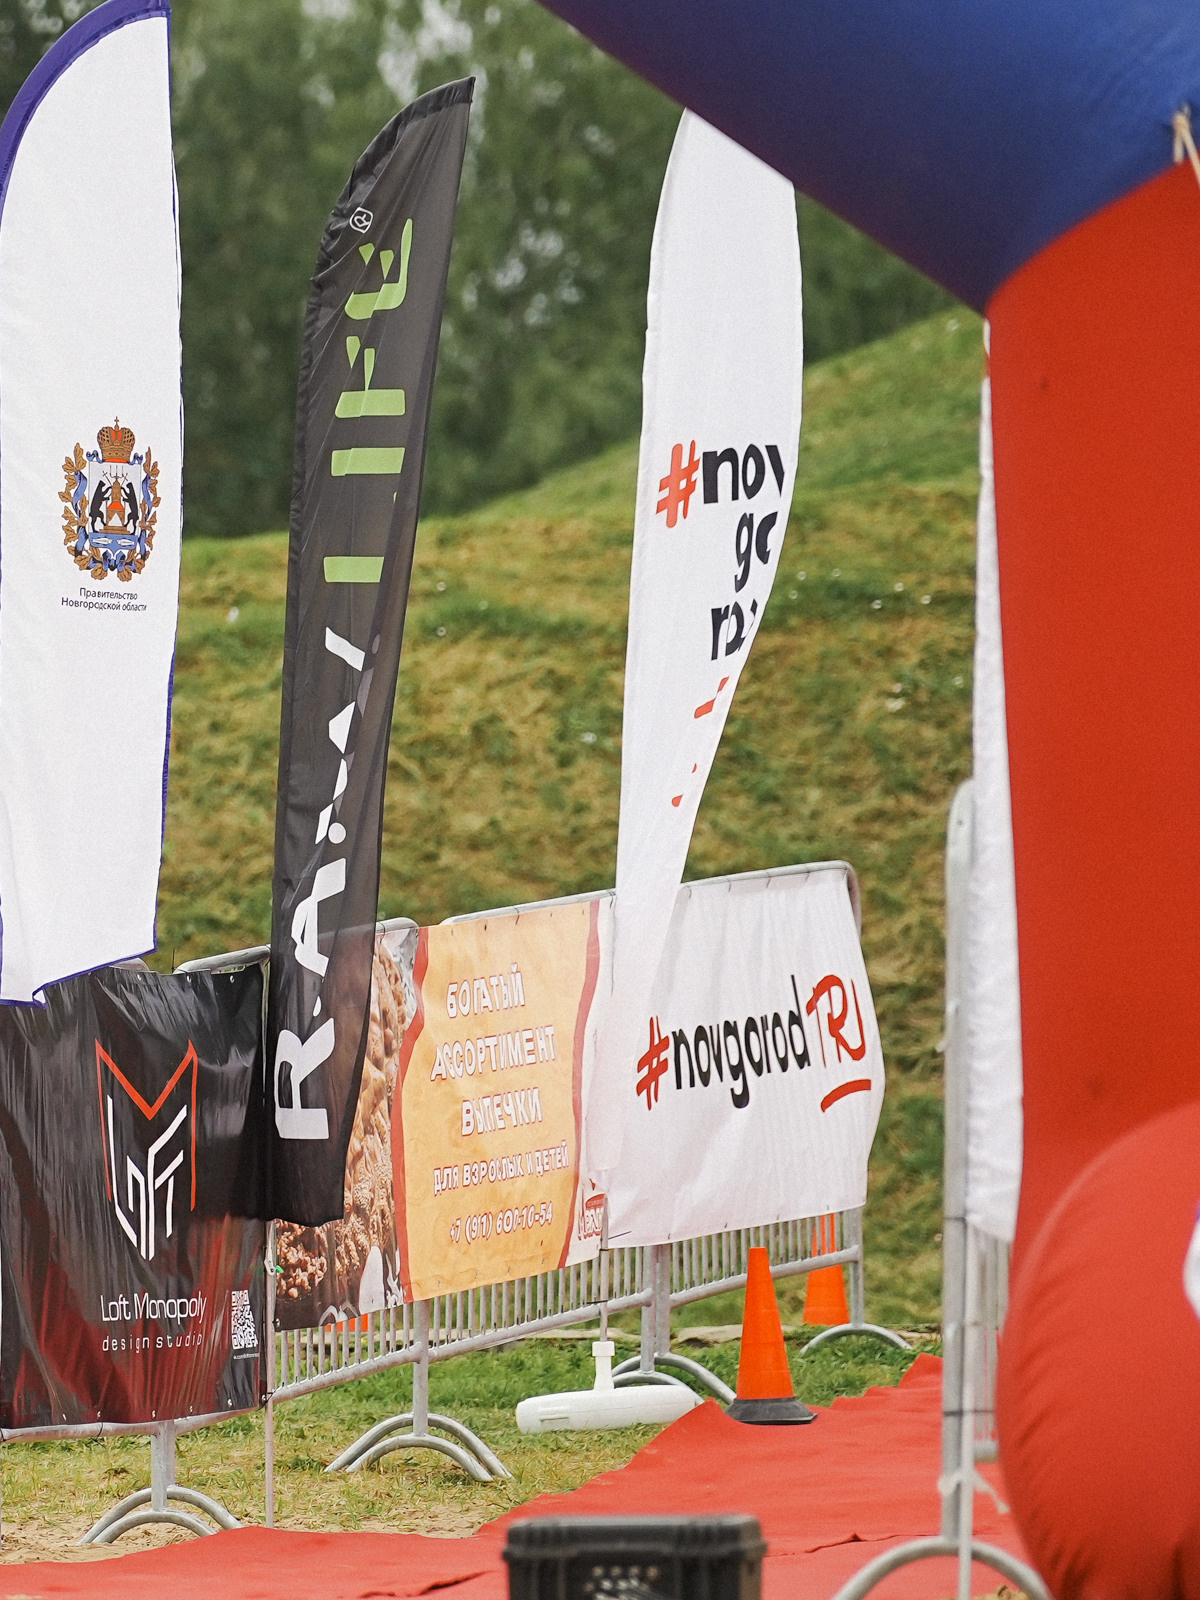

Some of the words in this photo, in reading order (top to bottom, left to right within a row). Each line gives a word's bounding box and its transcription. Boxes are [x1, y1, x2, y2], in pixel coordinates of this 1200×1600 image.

[61, 597, 121, 611] Новгородской
[122, 601, 147, 612] области
[79, 587, 138, 601] Правительство
[446, 962, 525, 1019] БОГАТЫЙ
[430, 1024, 556, 1082] АССОРТИМЕНТ
[460, 1086, 543, 1137] ВЫПЕЧКИ
[433, 1164, 459, 1197] ДЛЯ
[525, 1151, 534, 1176] И
[534, 1139, 569, 1178] ДЕТЕЙ
[100, 1293, 131, 1322] Loft
[133, 1290, 207, 1325] Monopoly
[102, 1335, 150, 1353] design
[155, 1331, 203, 1349] studio
